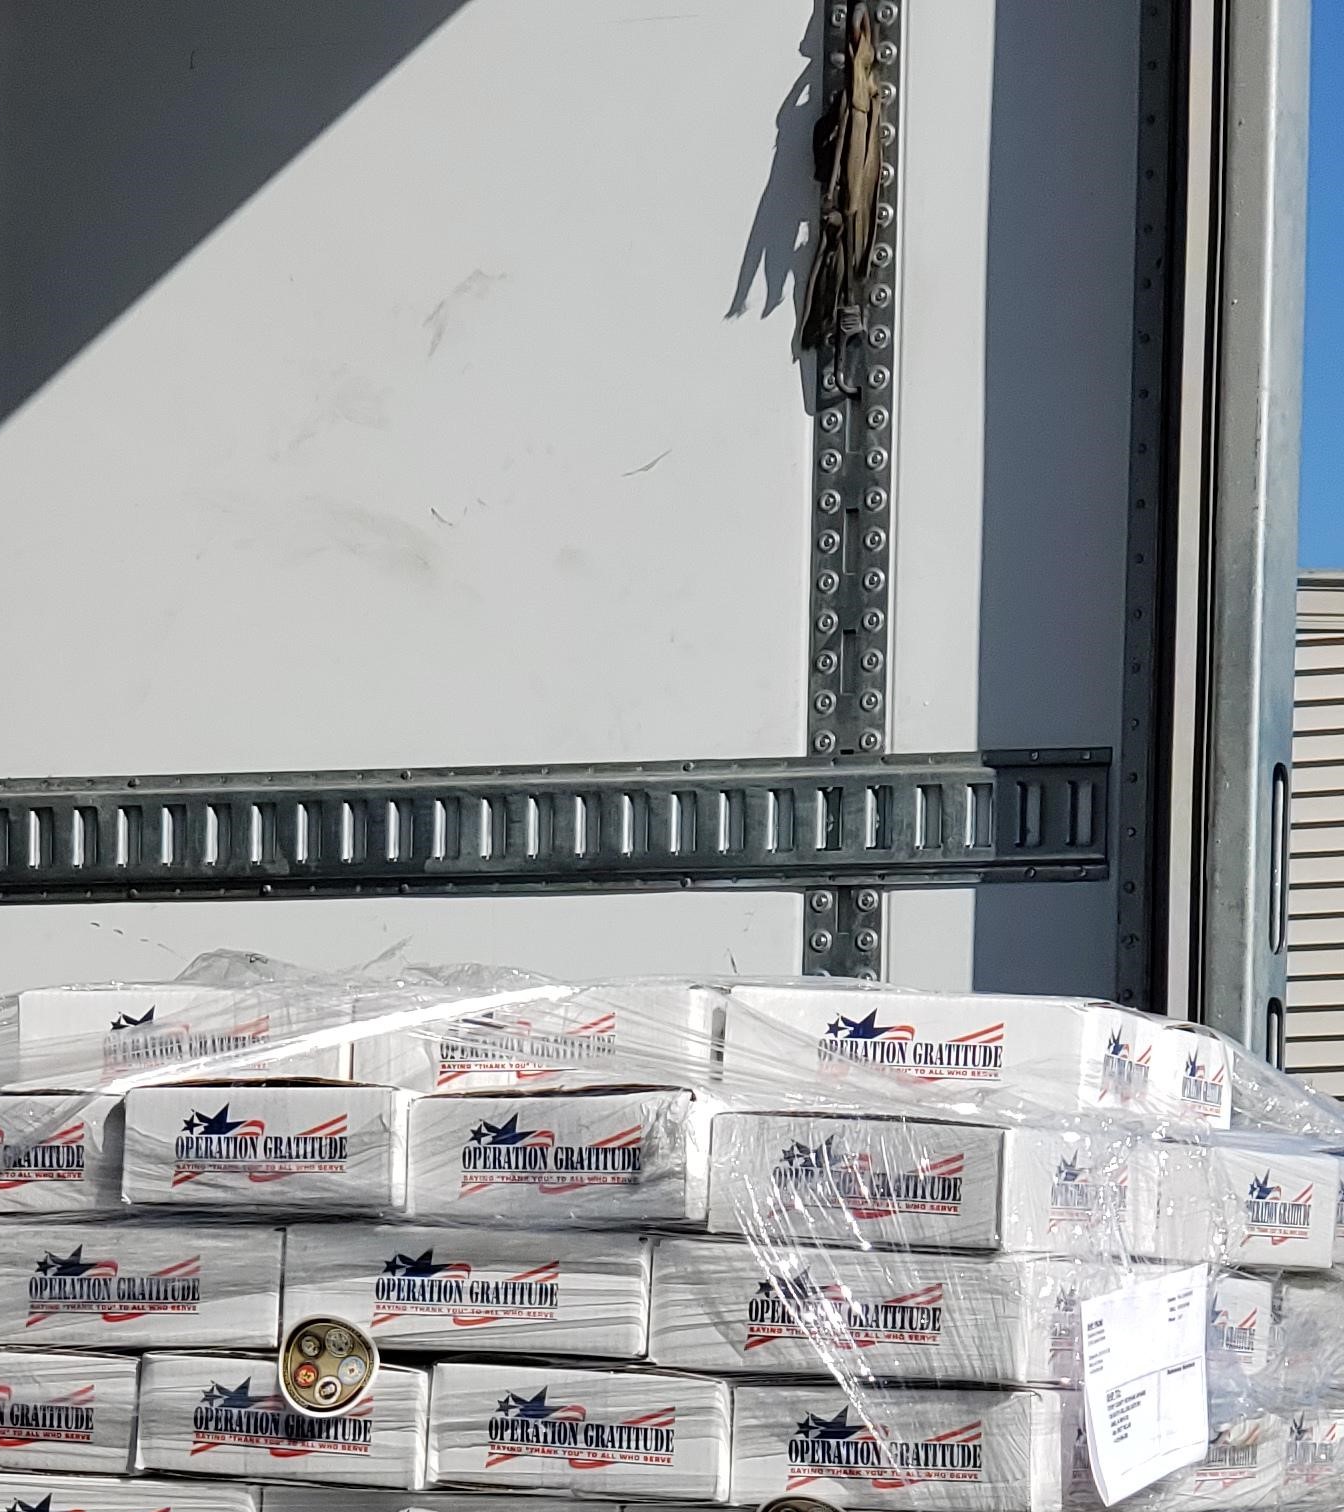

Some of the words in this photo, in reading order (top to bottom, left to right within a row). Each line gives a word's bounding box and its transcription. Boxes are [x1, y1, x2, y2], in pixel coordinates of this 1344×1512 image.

[817, 1039, 908, 1065] OPERATION
[913, 1041, 1003, 1068] GRATITUDE
[175, 1136, 257, 1160] OPERATION
[263, 1137, 347, 1160] GRATITUDE
[462, 1147, 549, 1171] OPERATION
[555, 1147, 641, 1171] GRATITUDE
[29, 1277, 110, 1301] OPERATION
[117, 1278, 200, 1302] GRATITUDE
[375, 1277, 463, 1304] OPERATION
[469, 1281, 559, 1307] GRATITUDE
[848, 1303, 941, 1332] GRATITUDE
[9, 1403, 94, 1430] GRATITUDE
[193, 1406, 280, 1435] OPERATION
[285, 1411, 372, 1443] GRATITUDE
[488, 1417, 578, 1446] OPERATION
[584, 1422, 674, 1453] GRATITUDE
[789, 1439, 881, 1466] OPERATION
